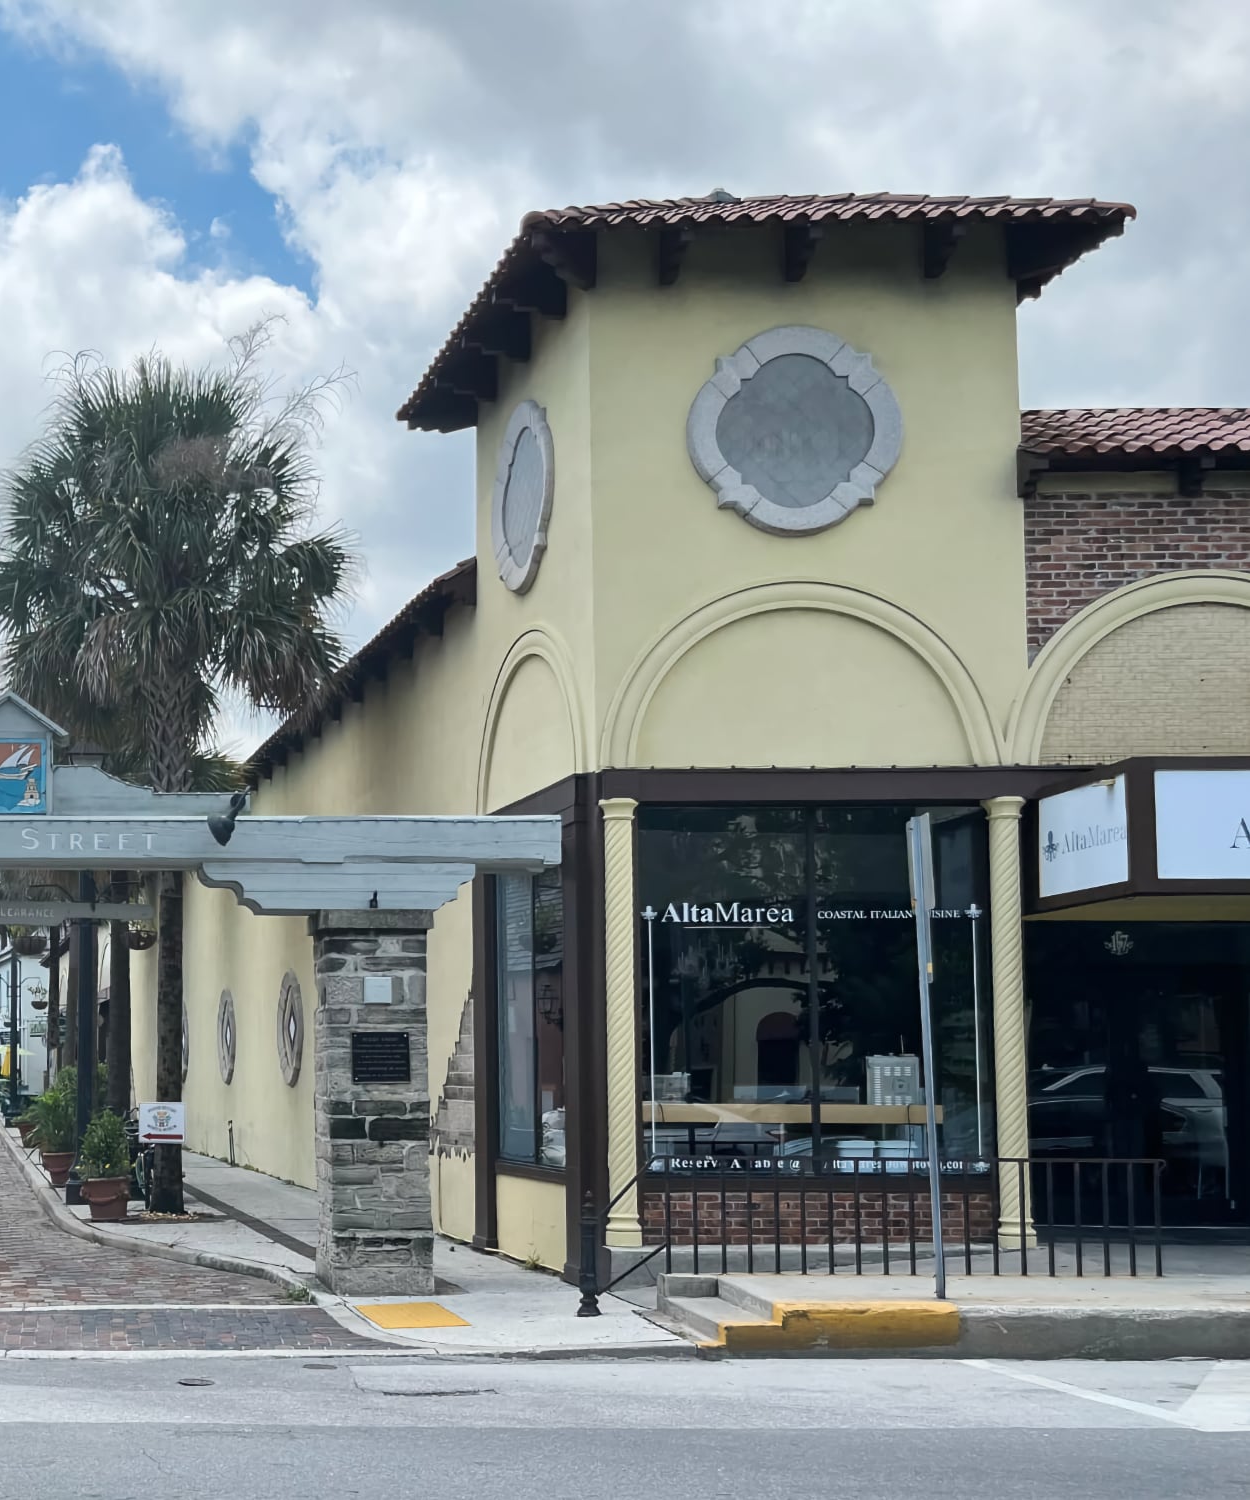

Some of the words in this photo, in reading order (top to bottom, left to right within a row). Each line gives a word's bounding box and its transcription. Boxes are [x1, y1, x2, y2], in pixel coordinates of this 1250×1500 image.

[1061, 825, 1127, 854] AltaMarea
[661, 902, 794, 922] AltaMarea
[817, 910, 867, 919] COASTAL
[870, 910, 913, 919] ITALIAN
[671, 1158, 723, 1168] Reserv
